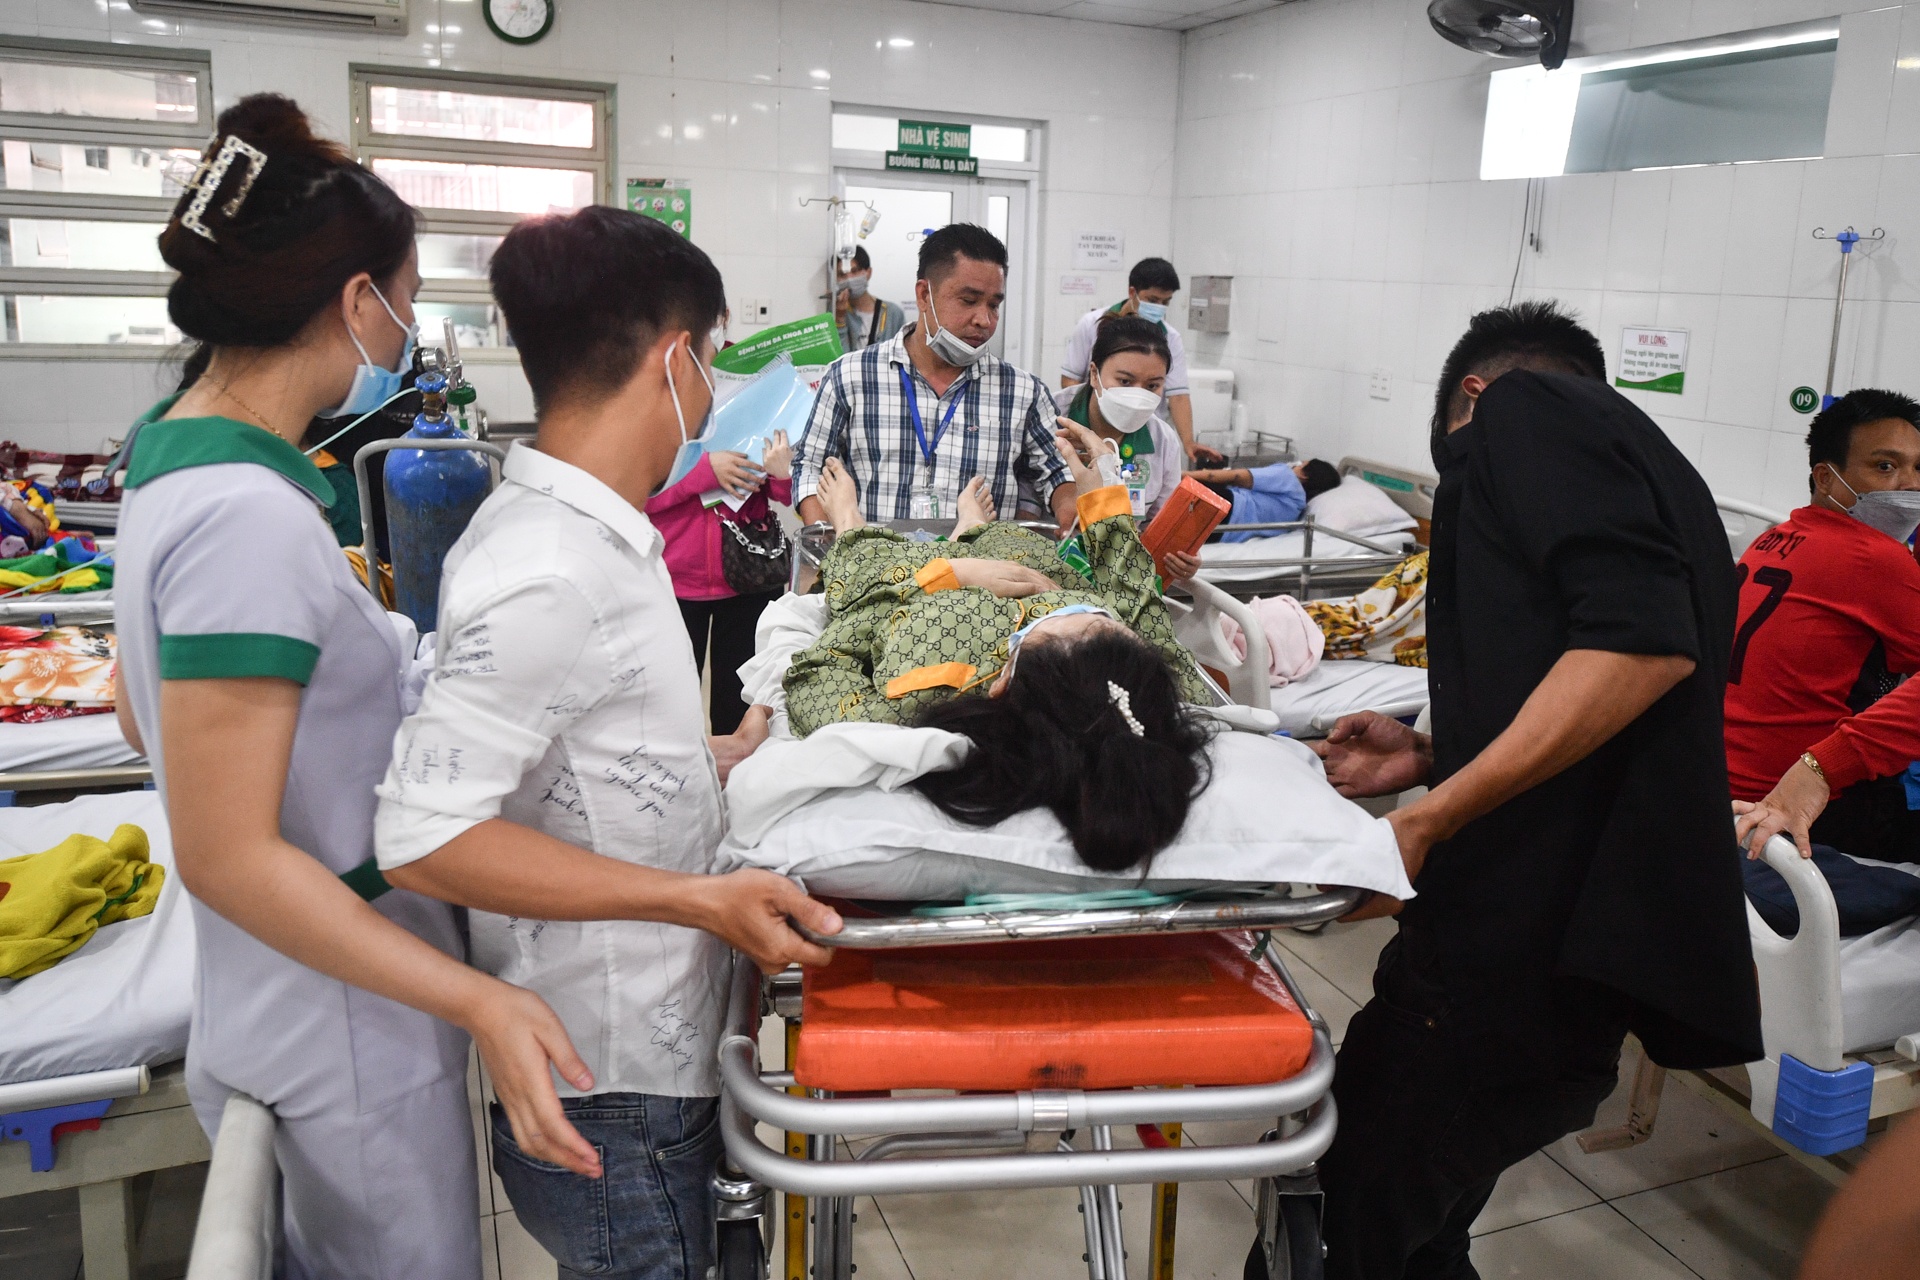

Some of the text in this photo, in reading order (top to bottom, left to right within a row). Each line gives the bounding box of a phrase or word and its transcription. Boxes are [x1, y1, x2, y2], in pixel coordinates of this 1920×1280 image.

[901, 126, 969, 150] NHÀ VỆ SINH
[782, 330, 803, 340] KHOA
[803, 327, 814, 335] AN
[1796, 392, 1813, 407] 09
[1727, 562, 1793, 686] 7
[617, 755, 647, 784] they
[636, 800, 667, 819] you
